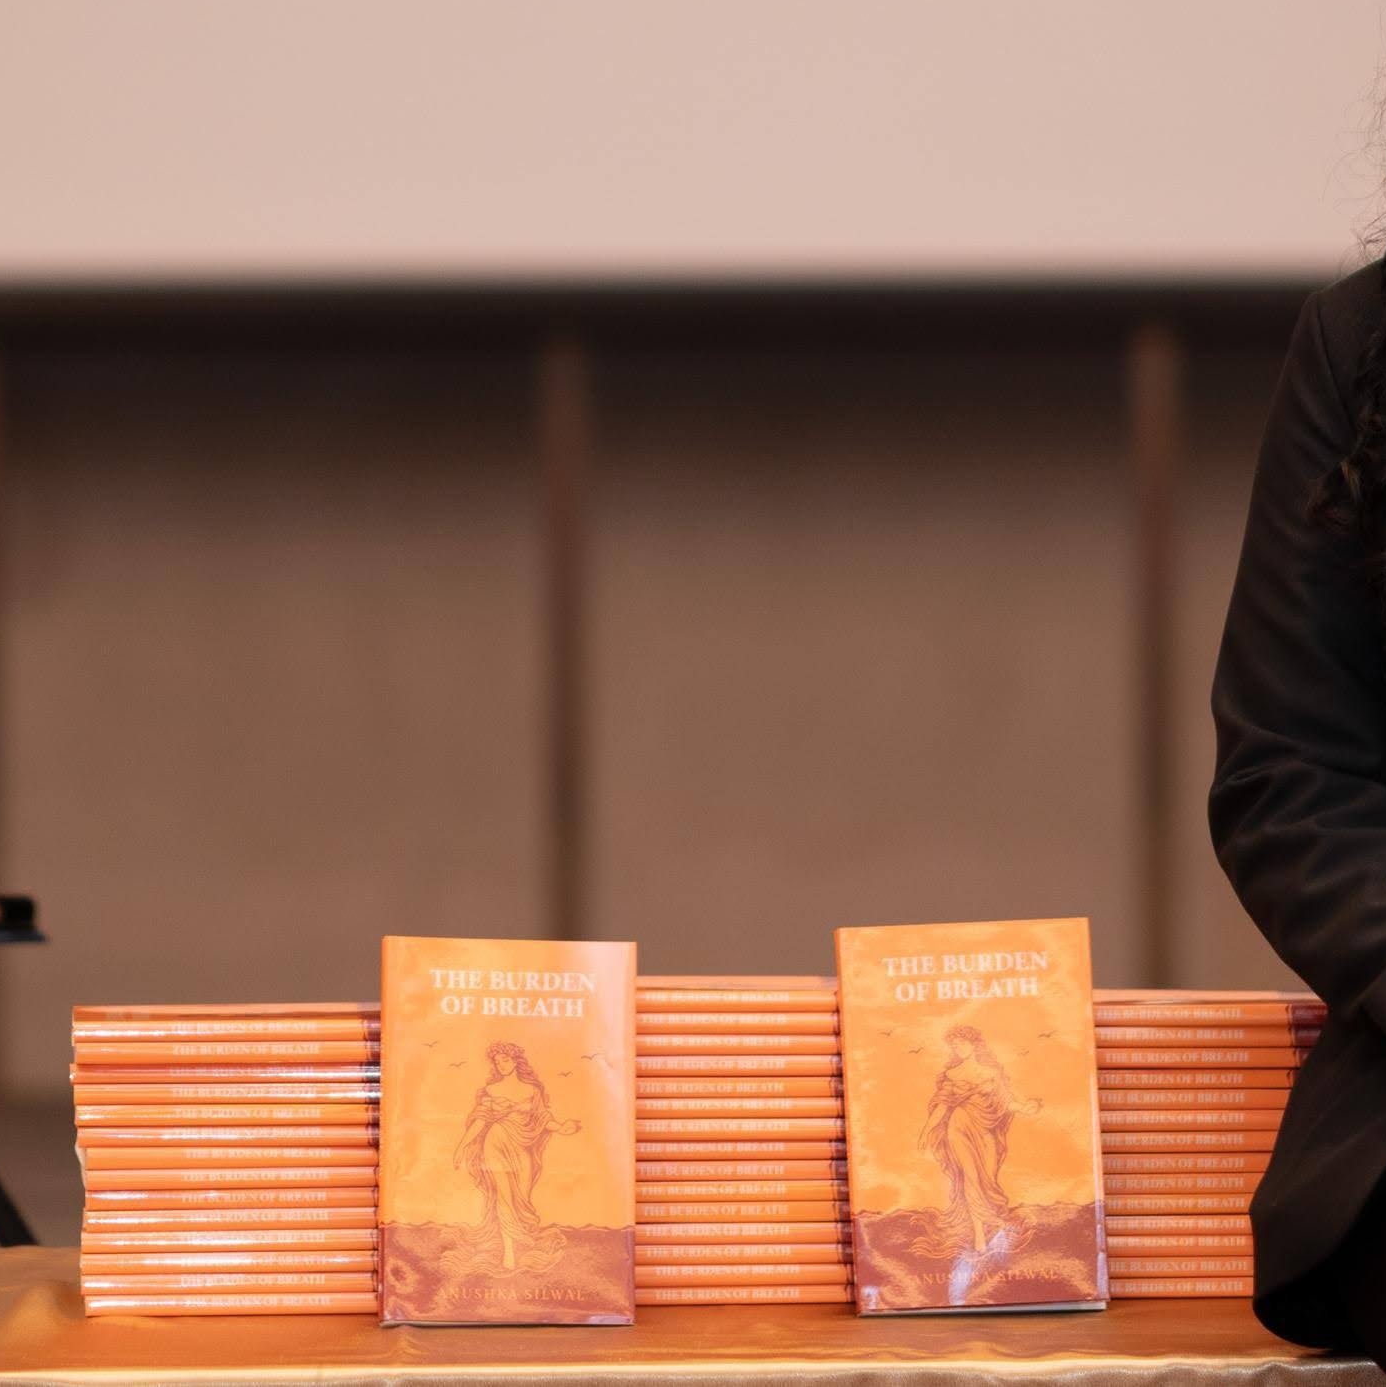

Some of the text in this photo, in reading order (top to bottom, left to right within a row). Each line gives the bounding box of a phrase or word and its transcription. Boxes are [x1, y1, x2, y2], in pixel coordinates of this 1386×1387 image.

[881, 950, 1050, 977] THE BURDEN
[429, 969, 597, 993] THE BURDEN
[895, 977, 1040, 1002] OF BREATH
[440, 996, 585, 1018] OF BREATH
[1106, 1052, 1126, 1062] THE
[1131, 1052, 1181, 1062] BURDEN
[1201, 1052, 1249, 1062] BREATH
[1100, 1074, 1120, 1084] THE
[1125, 1074, 1175, 1084] BURDEN
[1195, 1074, 1243, 1084] BREATH
[1101, 1093, 1121, 1103] THE
[1126, 1093, 1175, 1103] BURDEN
[1197, 1093, 1244, 1103] BREATH
[1126, 1158, 1176, 1168] BURDEN
[1197, 1158, 1245, 1168] BREATH
[1127, 1198, 1177, 1209] BURDEN
[1197, 1198, 1245, 1208] BREATH
[645, 1205, 665, 1215] THE
[670, 1205, 720, 1215] BURDEN
[741, 1205, 789, 1215] BREATH
[1127, 1236, 1177, 1246] BURDEN
[1198, 1236, 1246, 1246] BREATH
[1129, 1261, 1179, 1272] BURDEN
[1200, 1261, 1248, 1272] BREATH
[998, 1269, 1059, 1283] SILWAL
[438, 1286, 586, 1302] ANUSHKA SILWAL
